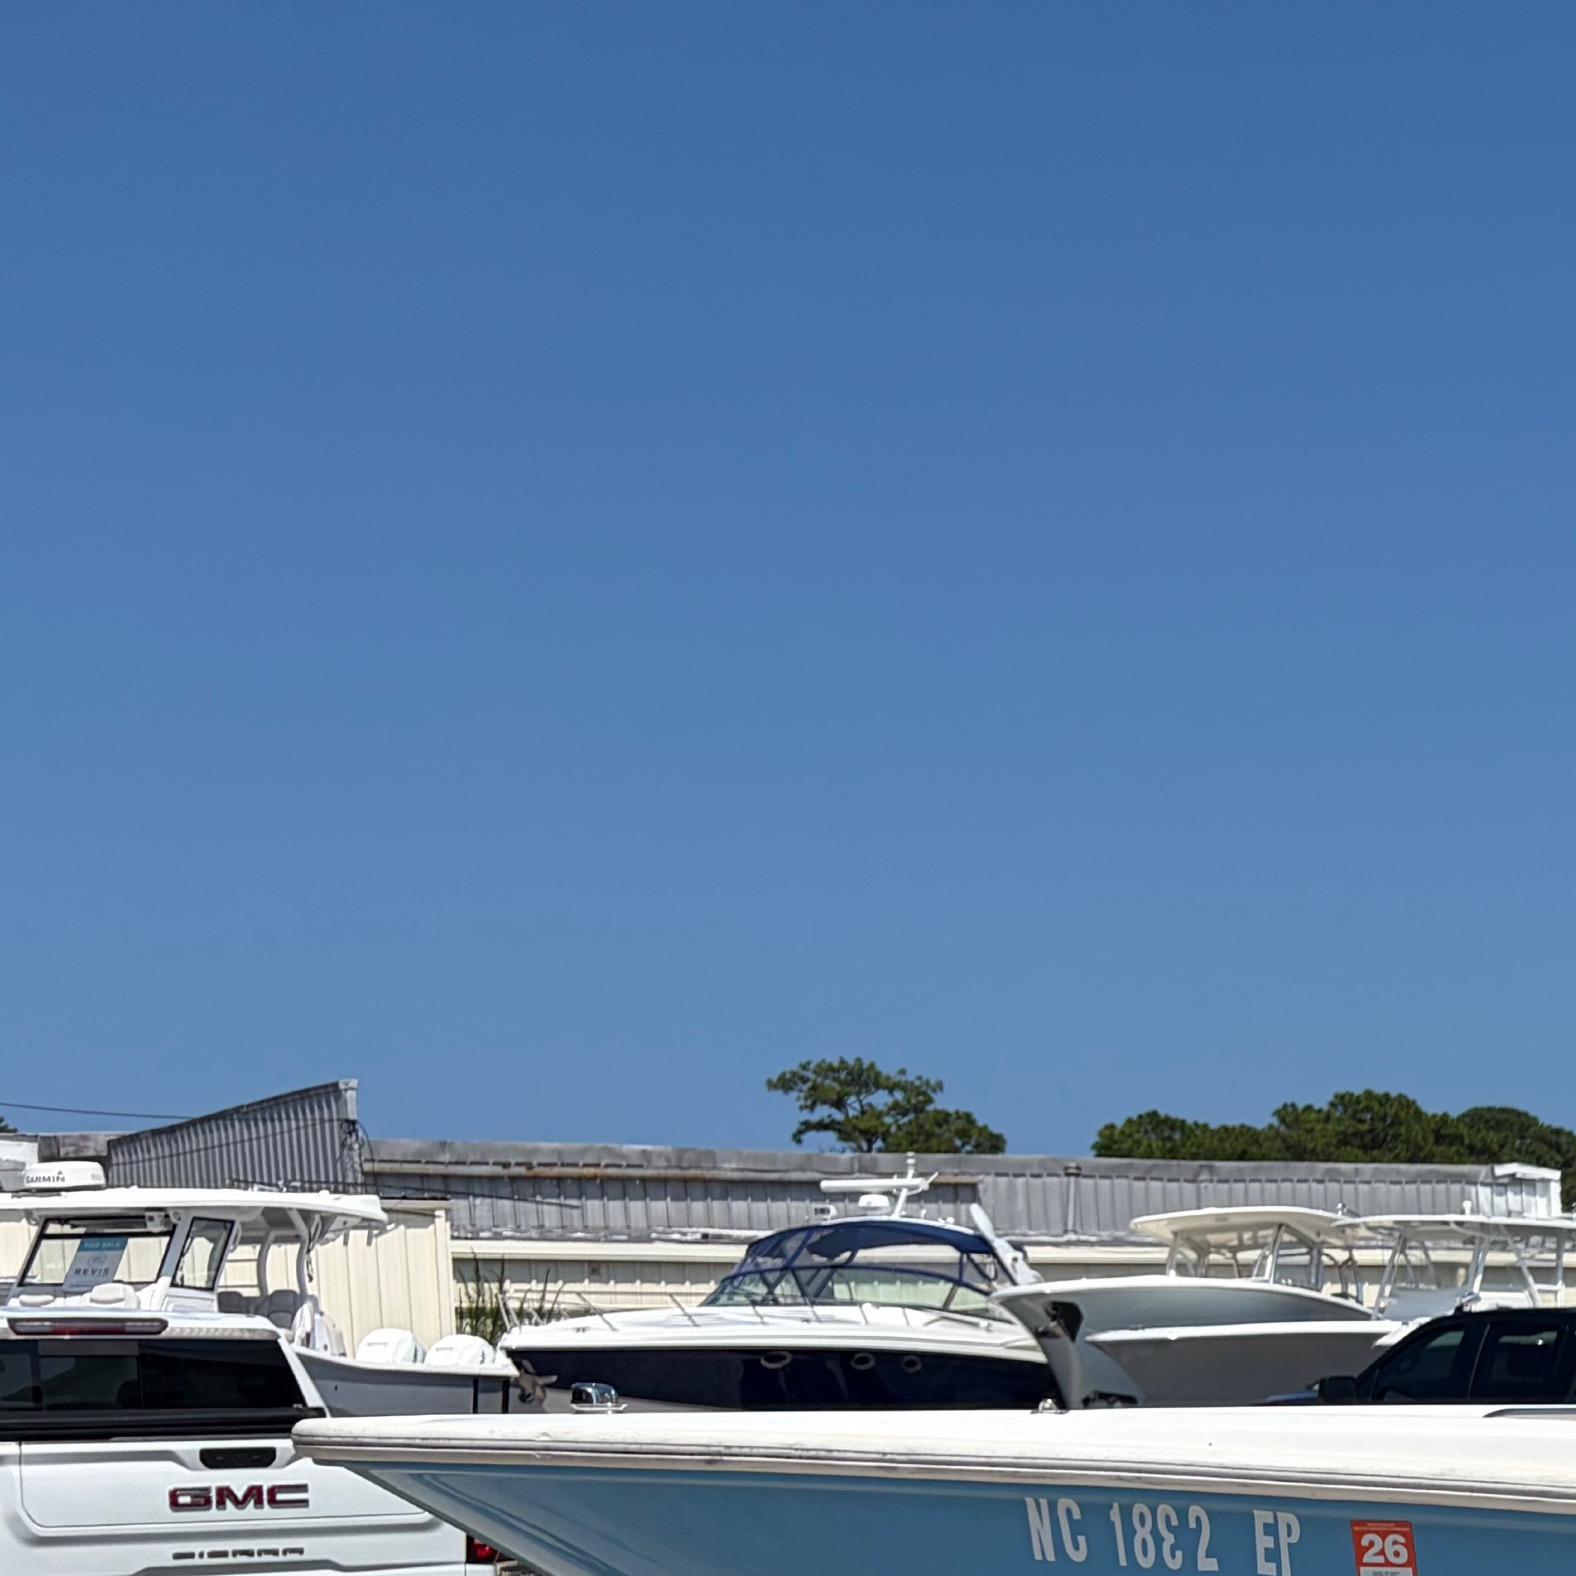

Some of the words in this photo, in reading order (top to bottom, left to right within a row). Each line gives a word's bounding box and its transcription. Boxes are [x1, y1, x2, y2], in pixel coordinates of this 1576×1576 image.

[169, 1484, 310, 1512] GMC
[1025, 1497, 1088, 1563] NC
[172, 1547, 305, 1560] SIERRA
[1360, 1532, 1409, 1565] 26
